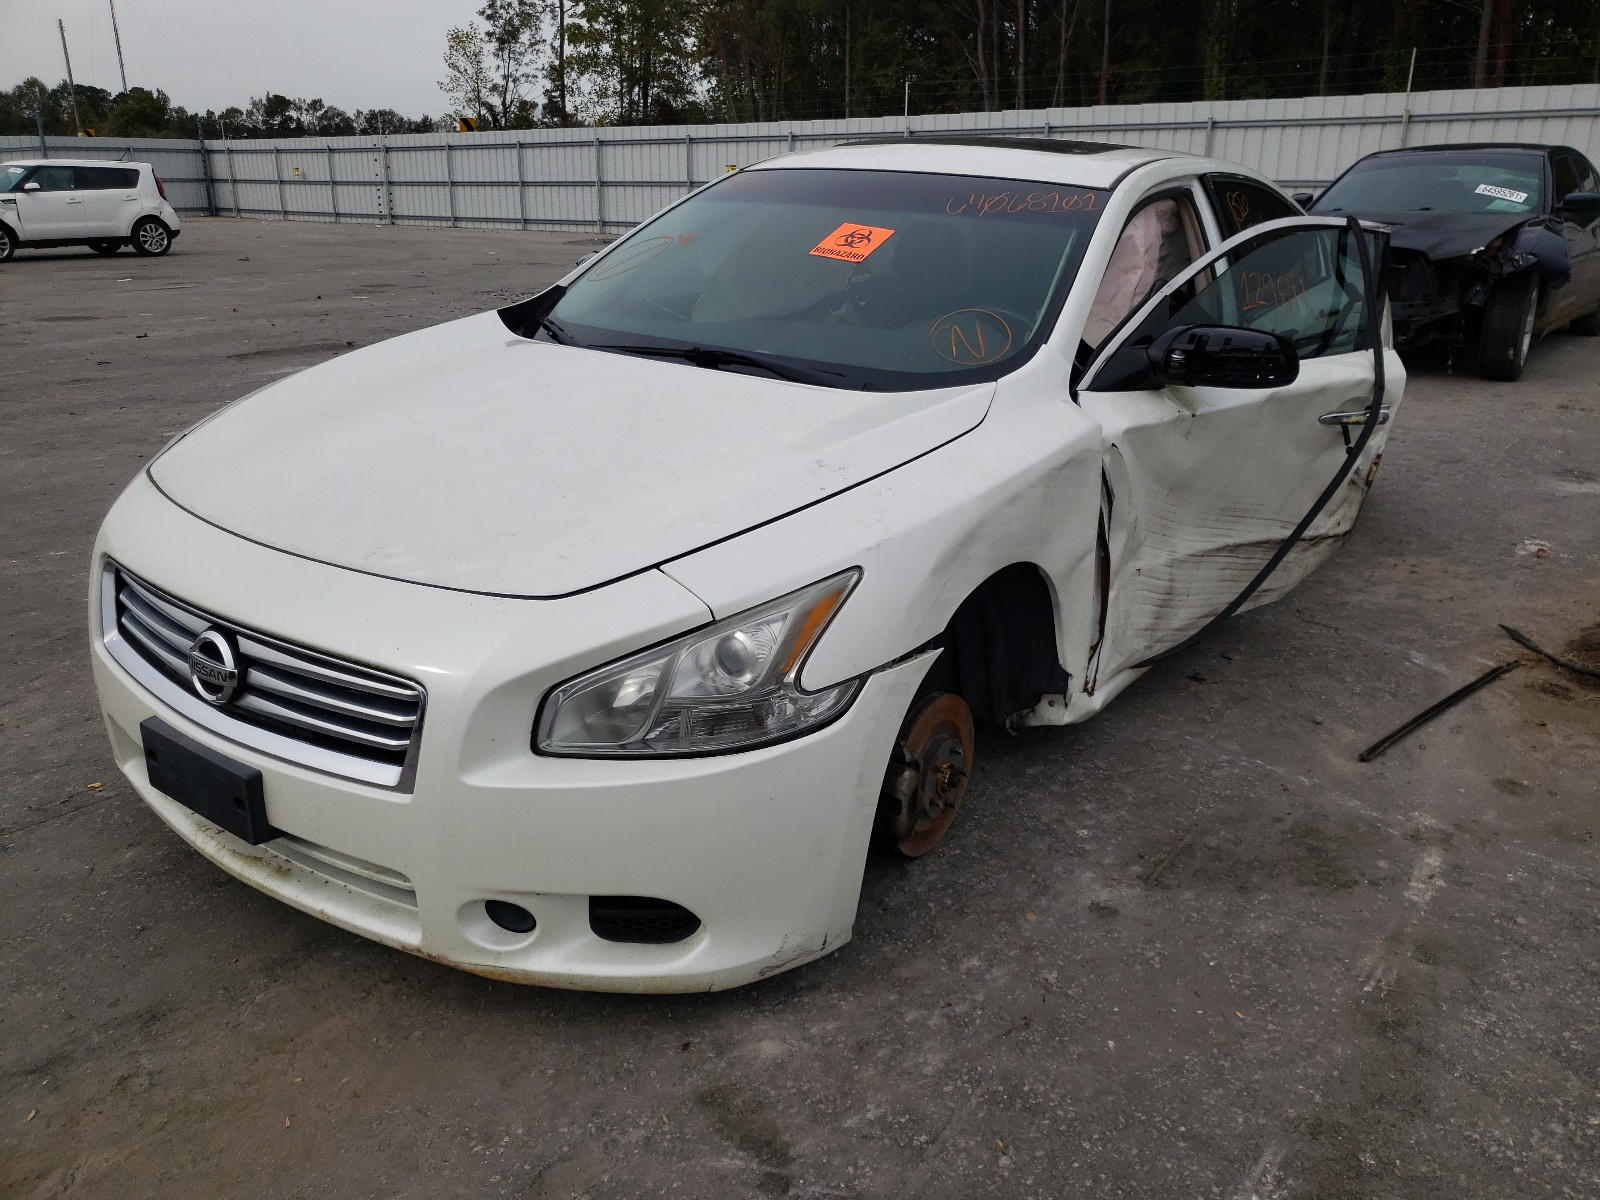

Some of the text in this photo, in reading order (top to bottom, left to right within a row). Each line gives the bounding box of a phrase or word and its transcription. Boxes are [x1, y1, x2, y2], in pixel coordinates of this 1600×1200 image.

[812, 246, 865, 260] BIOHAZARD
[950, 318, 987, 359] N
[190, 659, 227, 682] NISSAN
